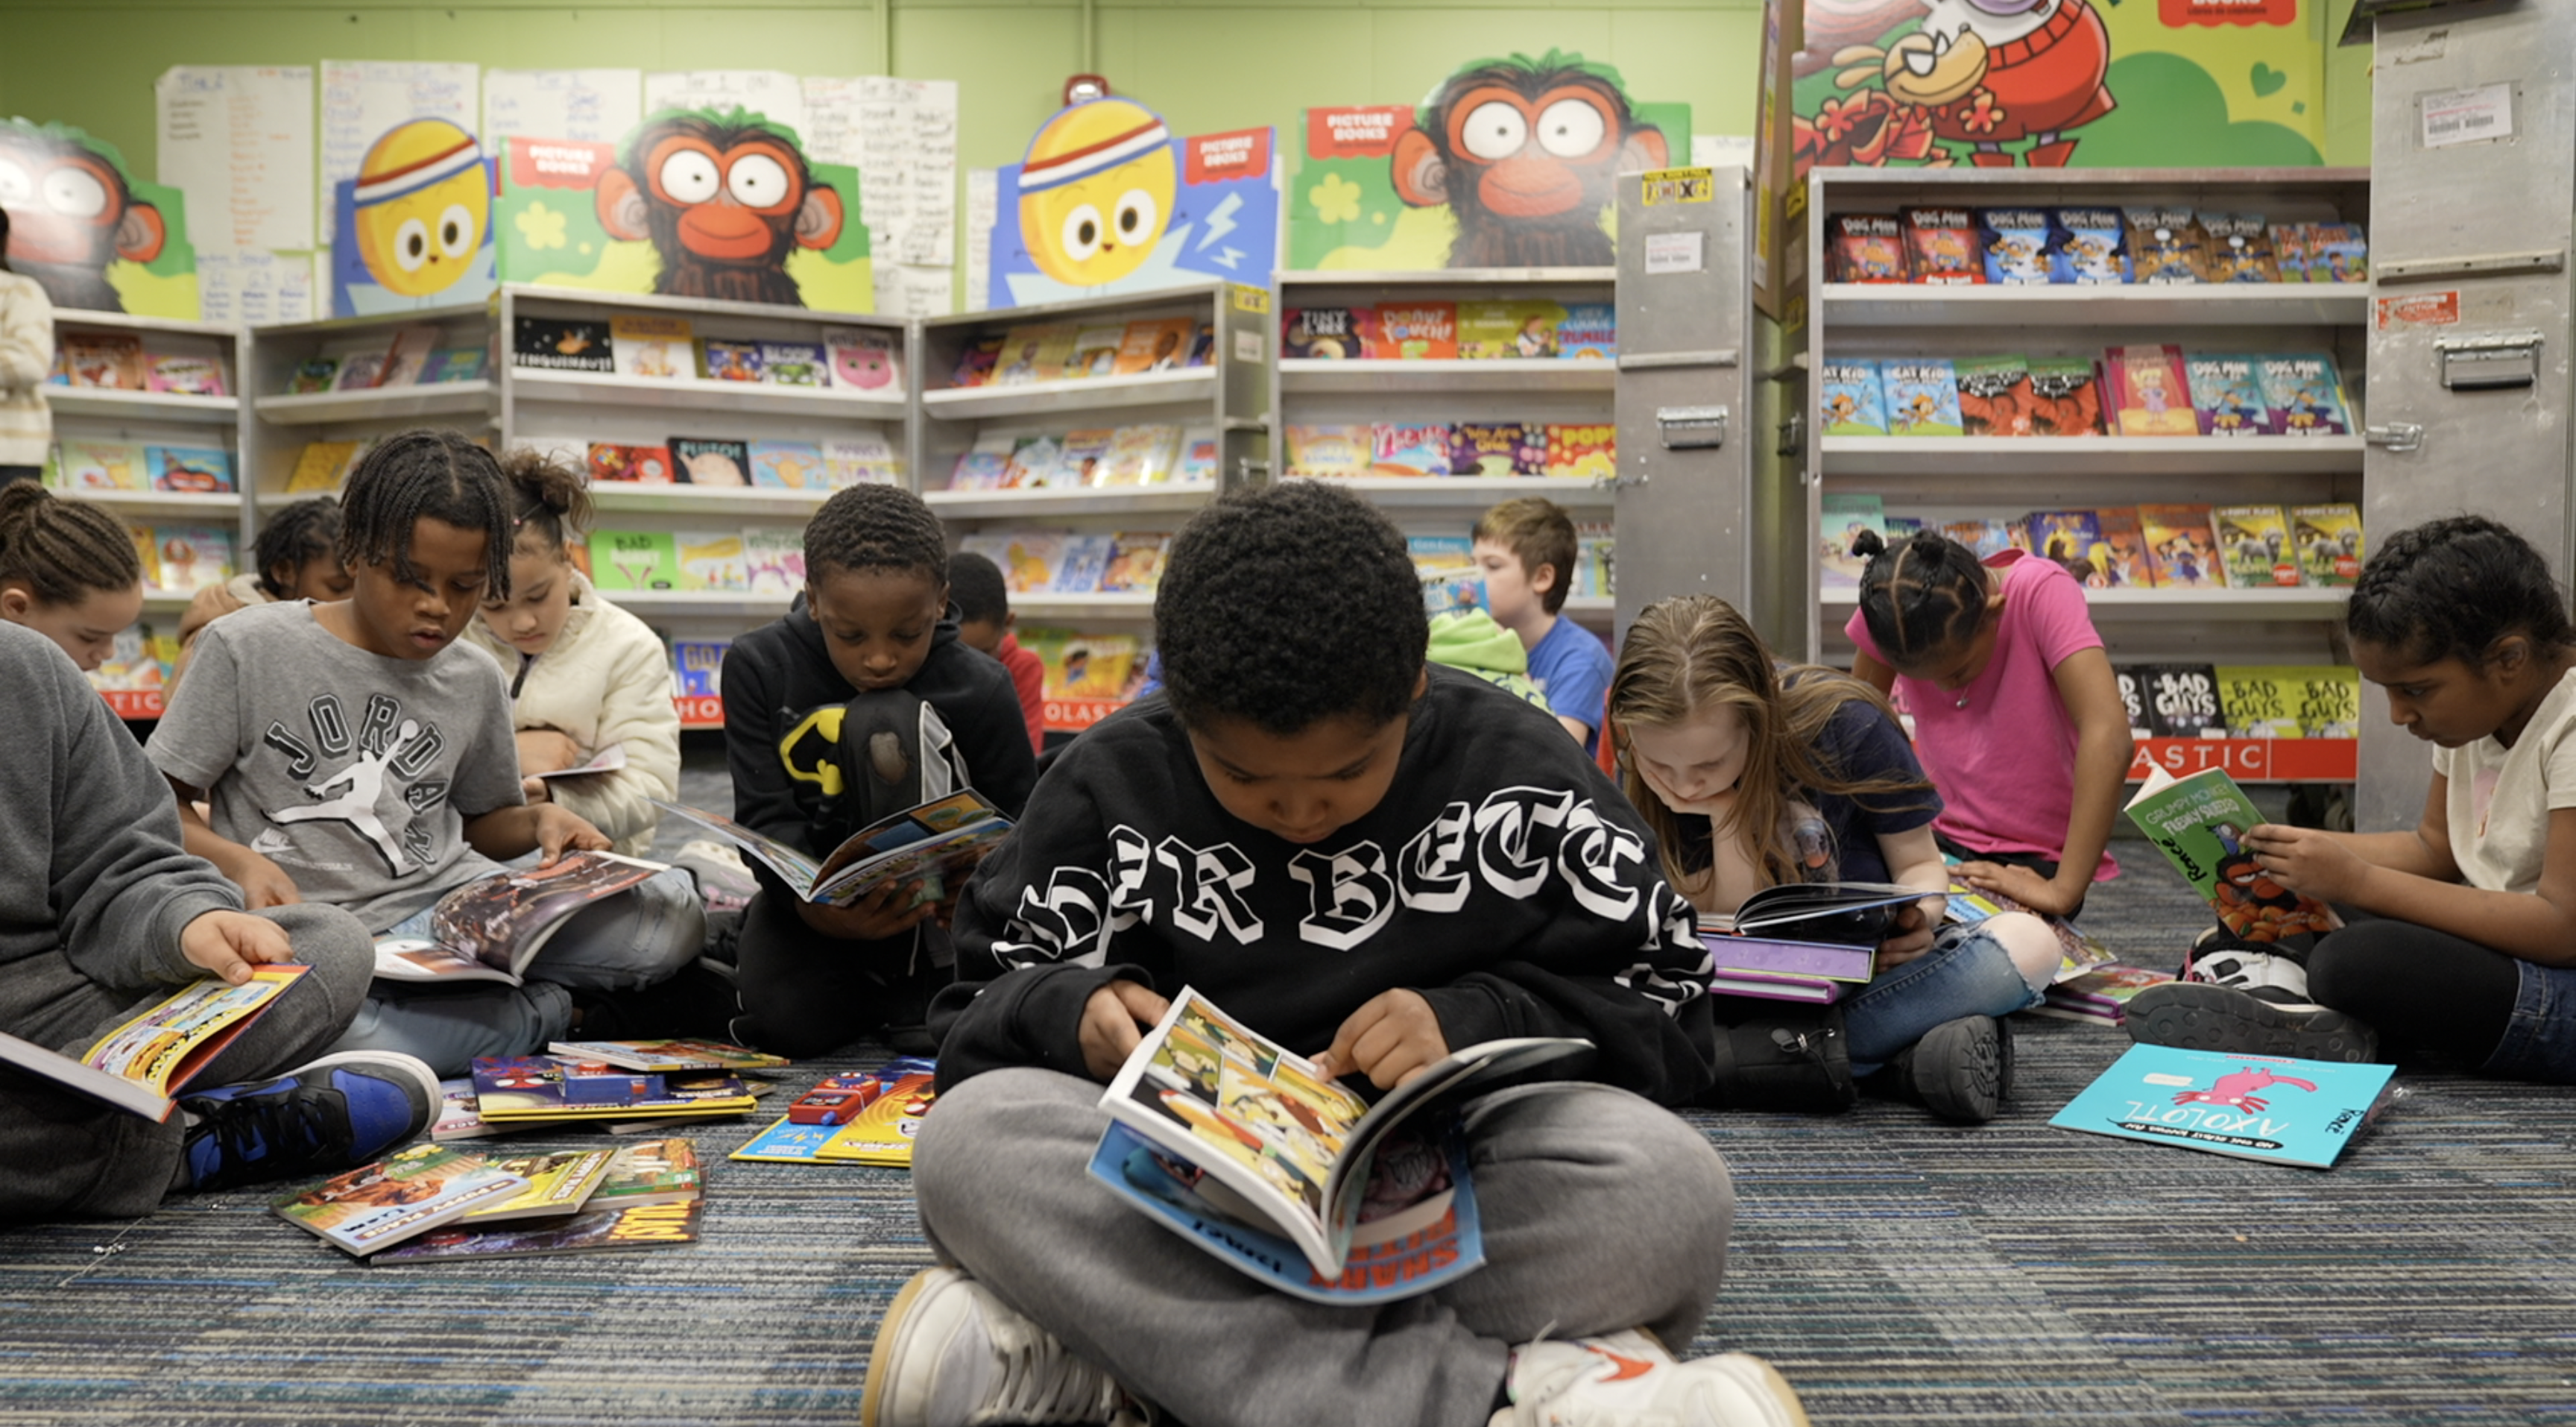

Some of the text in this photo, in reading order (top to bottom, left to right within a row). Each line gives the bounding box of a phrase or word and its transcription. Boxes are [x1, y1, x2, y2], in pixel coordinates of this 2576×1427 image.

[1327, 113, 1395, 130] PICTURE
[1333, 126, 1388, 142] BOOKS
[530, 144, 596, 163] PICTURE
[1200, 136, 1253, 156] PICTURE
[537, 159, 590, 177] BOOKS
[1204, 151, 1248, 168] BOOKS
[1842, 217, 1898, 234] DOG MAN
[1912, 210, 1969, 227] DOG MAN
[2192, 361, 2250, 375] DOG MAN
[2264, 361, 2322, 375] DOG MAN
[2161, 672, 2210, 696] BAD
[2232, 680, 2278, 701] BAD
[2303, 680, 2351, 701] BAD
[2155, 693, 2217, 716] GUYS
[2226, 699, 2286, 720] GUYS
[2299, 700, 2358, 721] GUYS
[264, 692, 449, 865] JORDAN
[2124, 1100, 2291, 1138] AXOLOTL
[2254, 1139, 2276, 1150] NO
[431, 1187, 490, 1213] PUPPY
[362, 1211, 424, 1239] PLACE
